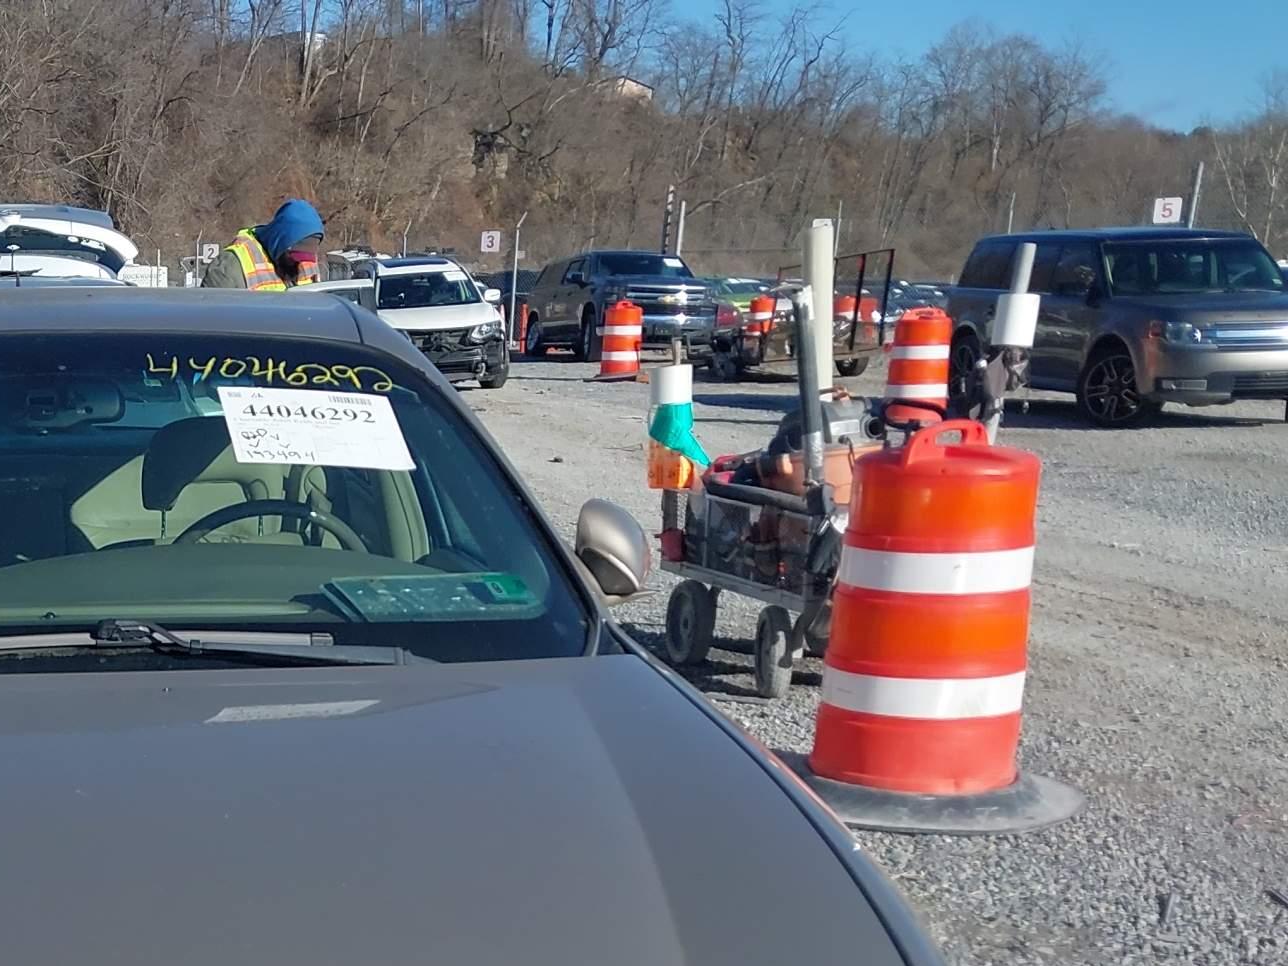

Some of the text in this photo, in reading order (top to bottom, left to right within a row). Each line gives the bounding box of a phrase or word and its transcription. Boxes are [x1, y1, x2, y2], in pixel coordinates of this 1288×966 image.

[1161, 202, 1173, 218] 5
[486, 235, 495, 249] 3
[207, 247, 216, 260] 2
[242, 404, 376, 424] 44046292
